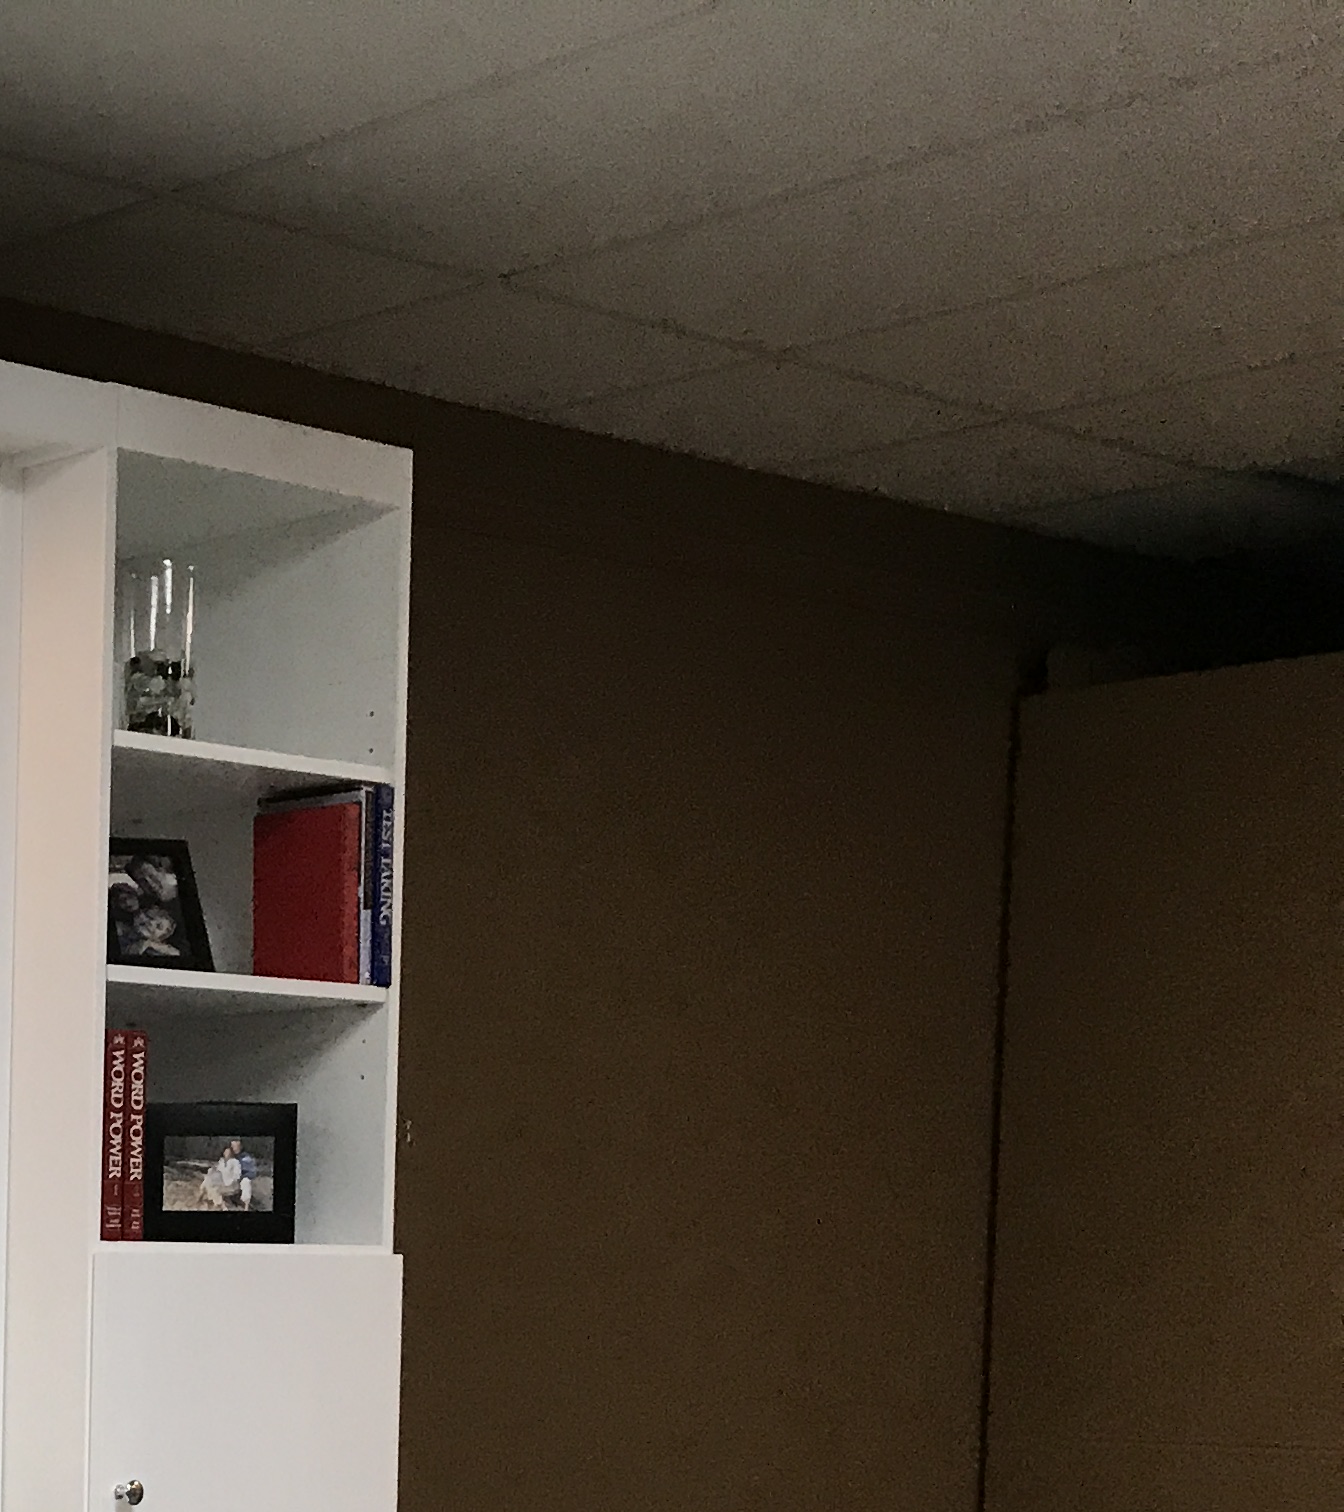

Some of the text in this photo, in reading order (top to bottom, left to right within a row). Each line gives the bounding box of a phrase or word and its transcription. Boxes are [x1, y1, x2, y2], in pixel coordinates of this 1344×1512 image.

[379, 808, 394, 926] TEST TAKING
[110, 1050, 125, 1108] WORD
[130, 1051, 145, 1110] WORD
[108, 1111, 123, 1179] POWER
[129, 1113, 144, 1181] POWER
